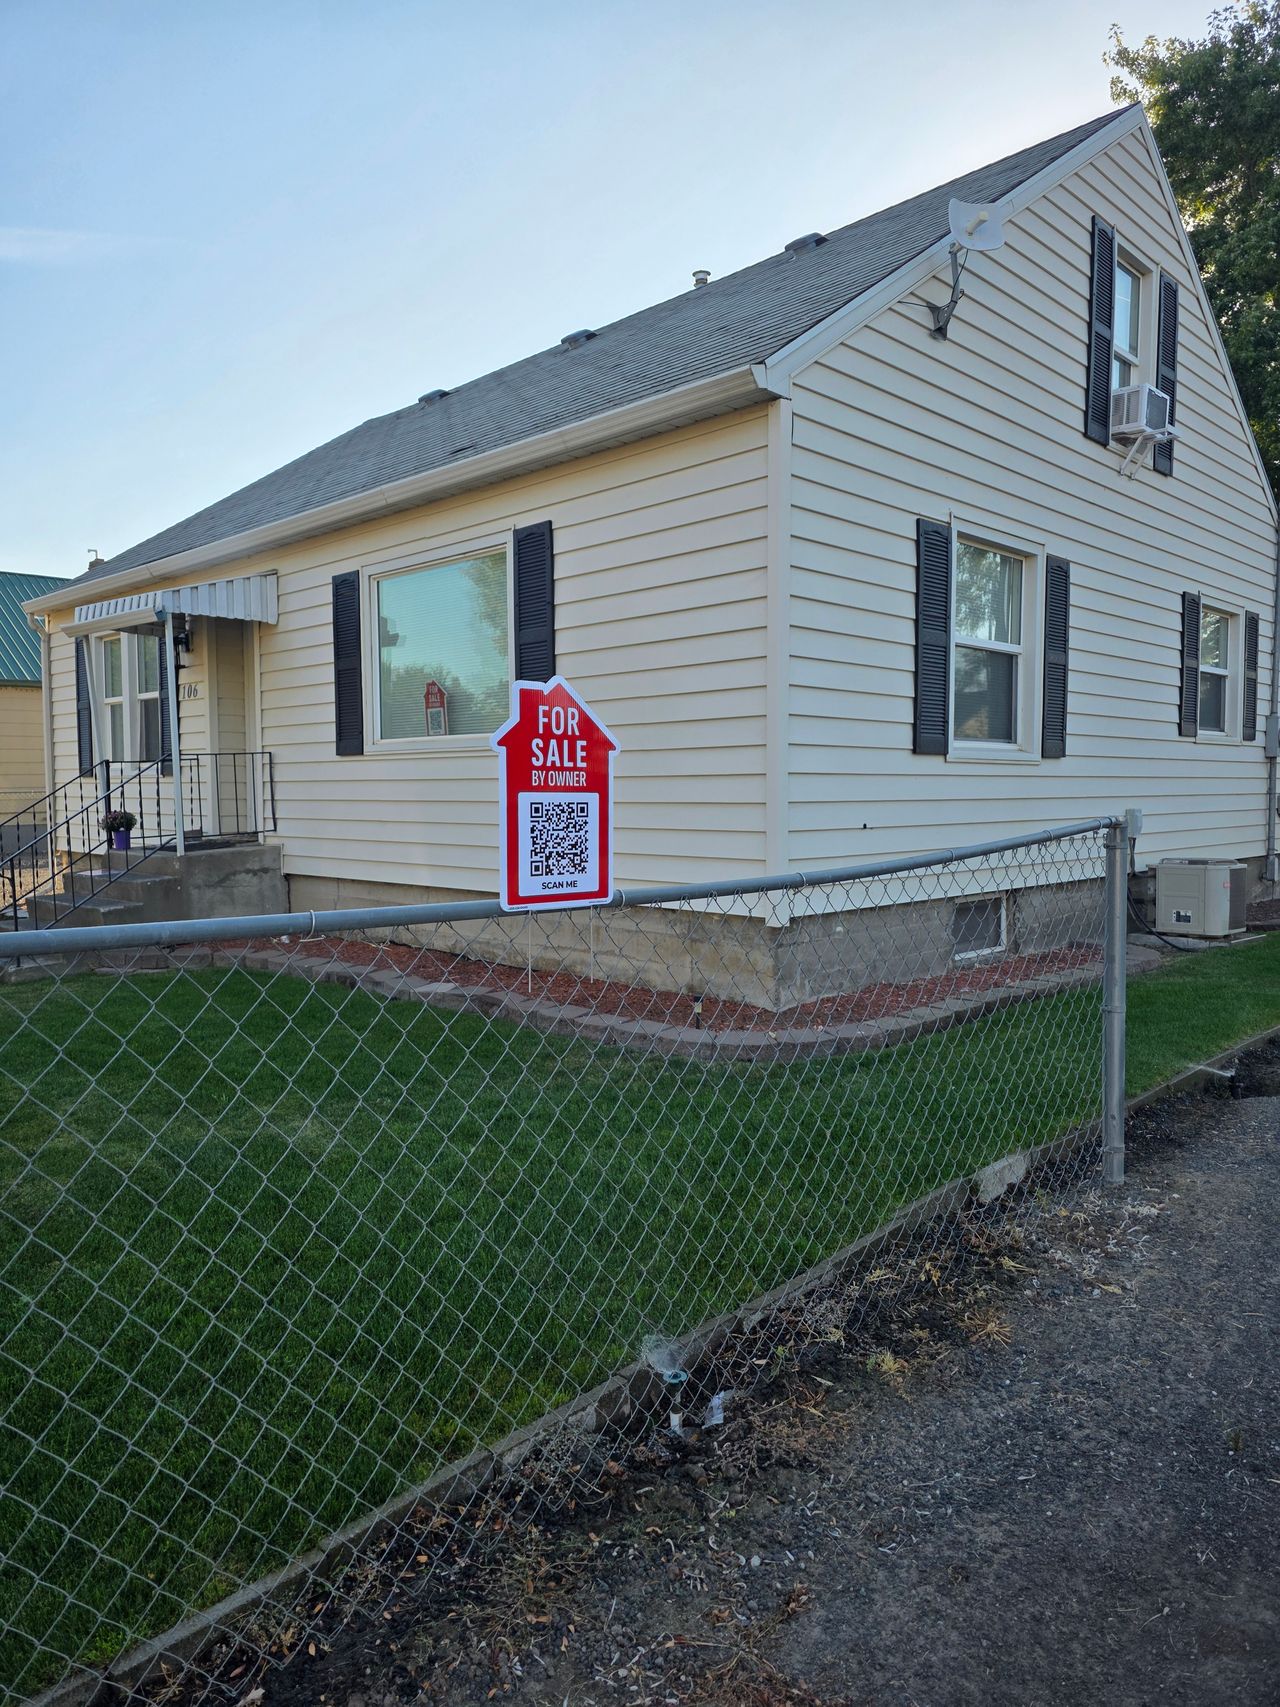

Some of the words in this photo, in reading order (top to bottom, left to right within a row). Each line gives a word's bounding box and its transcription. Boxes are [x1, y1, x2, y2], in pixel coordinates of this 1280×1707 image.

[182, 684, 198, 699] 106
[538, 705, 580, 736] FOR
[531, 738, 587, 767] SALE
[532, 770, 546, 786] BY
[548, 771, 587, 787] OWNER
[541, 881, 564, 890] SCAN
[566, 880, 578, 888] ME
